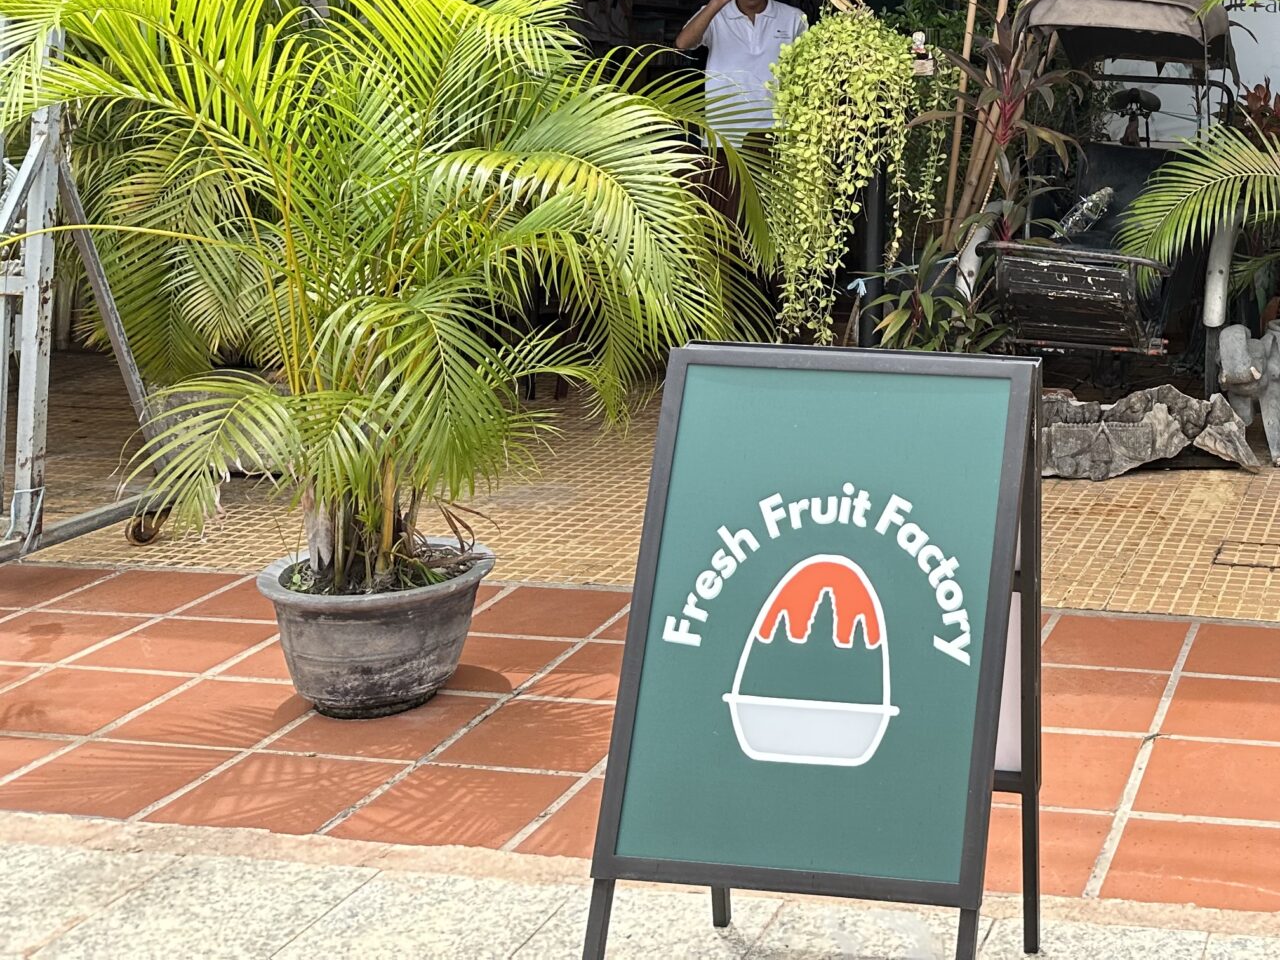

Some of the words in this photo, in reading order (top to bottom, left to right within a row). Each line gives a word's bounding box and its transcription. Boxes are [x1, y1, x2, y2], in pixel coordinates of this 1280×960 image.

[662, 525, 761, 647] Fresh
[758, 482, 872, 539] Fruit
[874, 493, 971, 666] Factory
